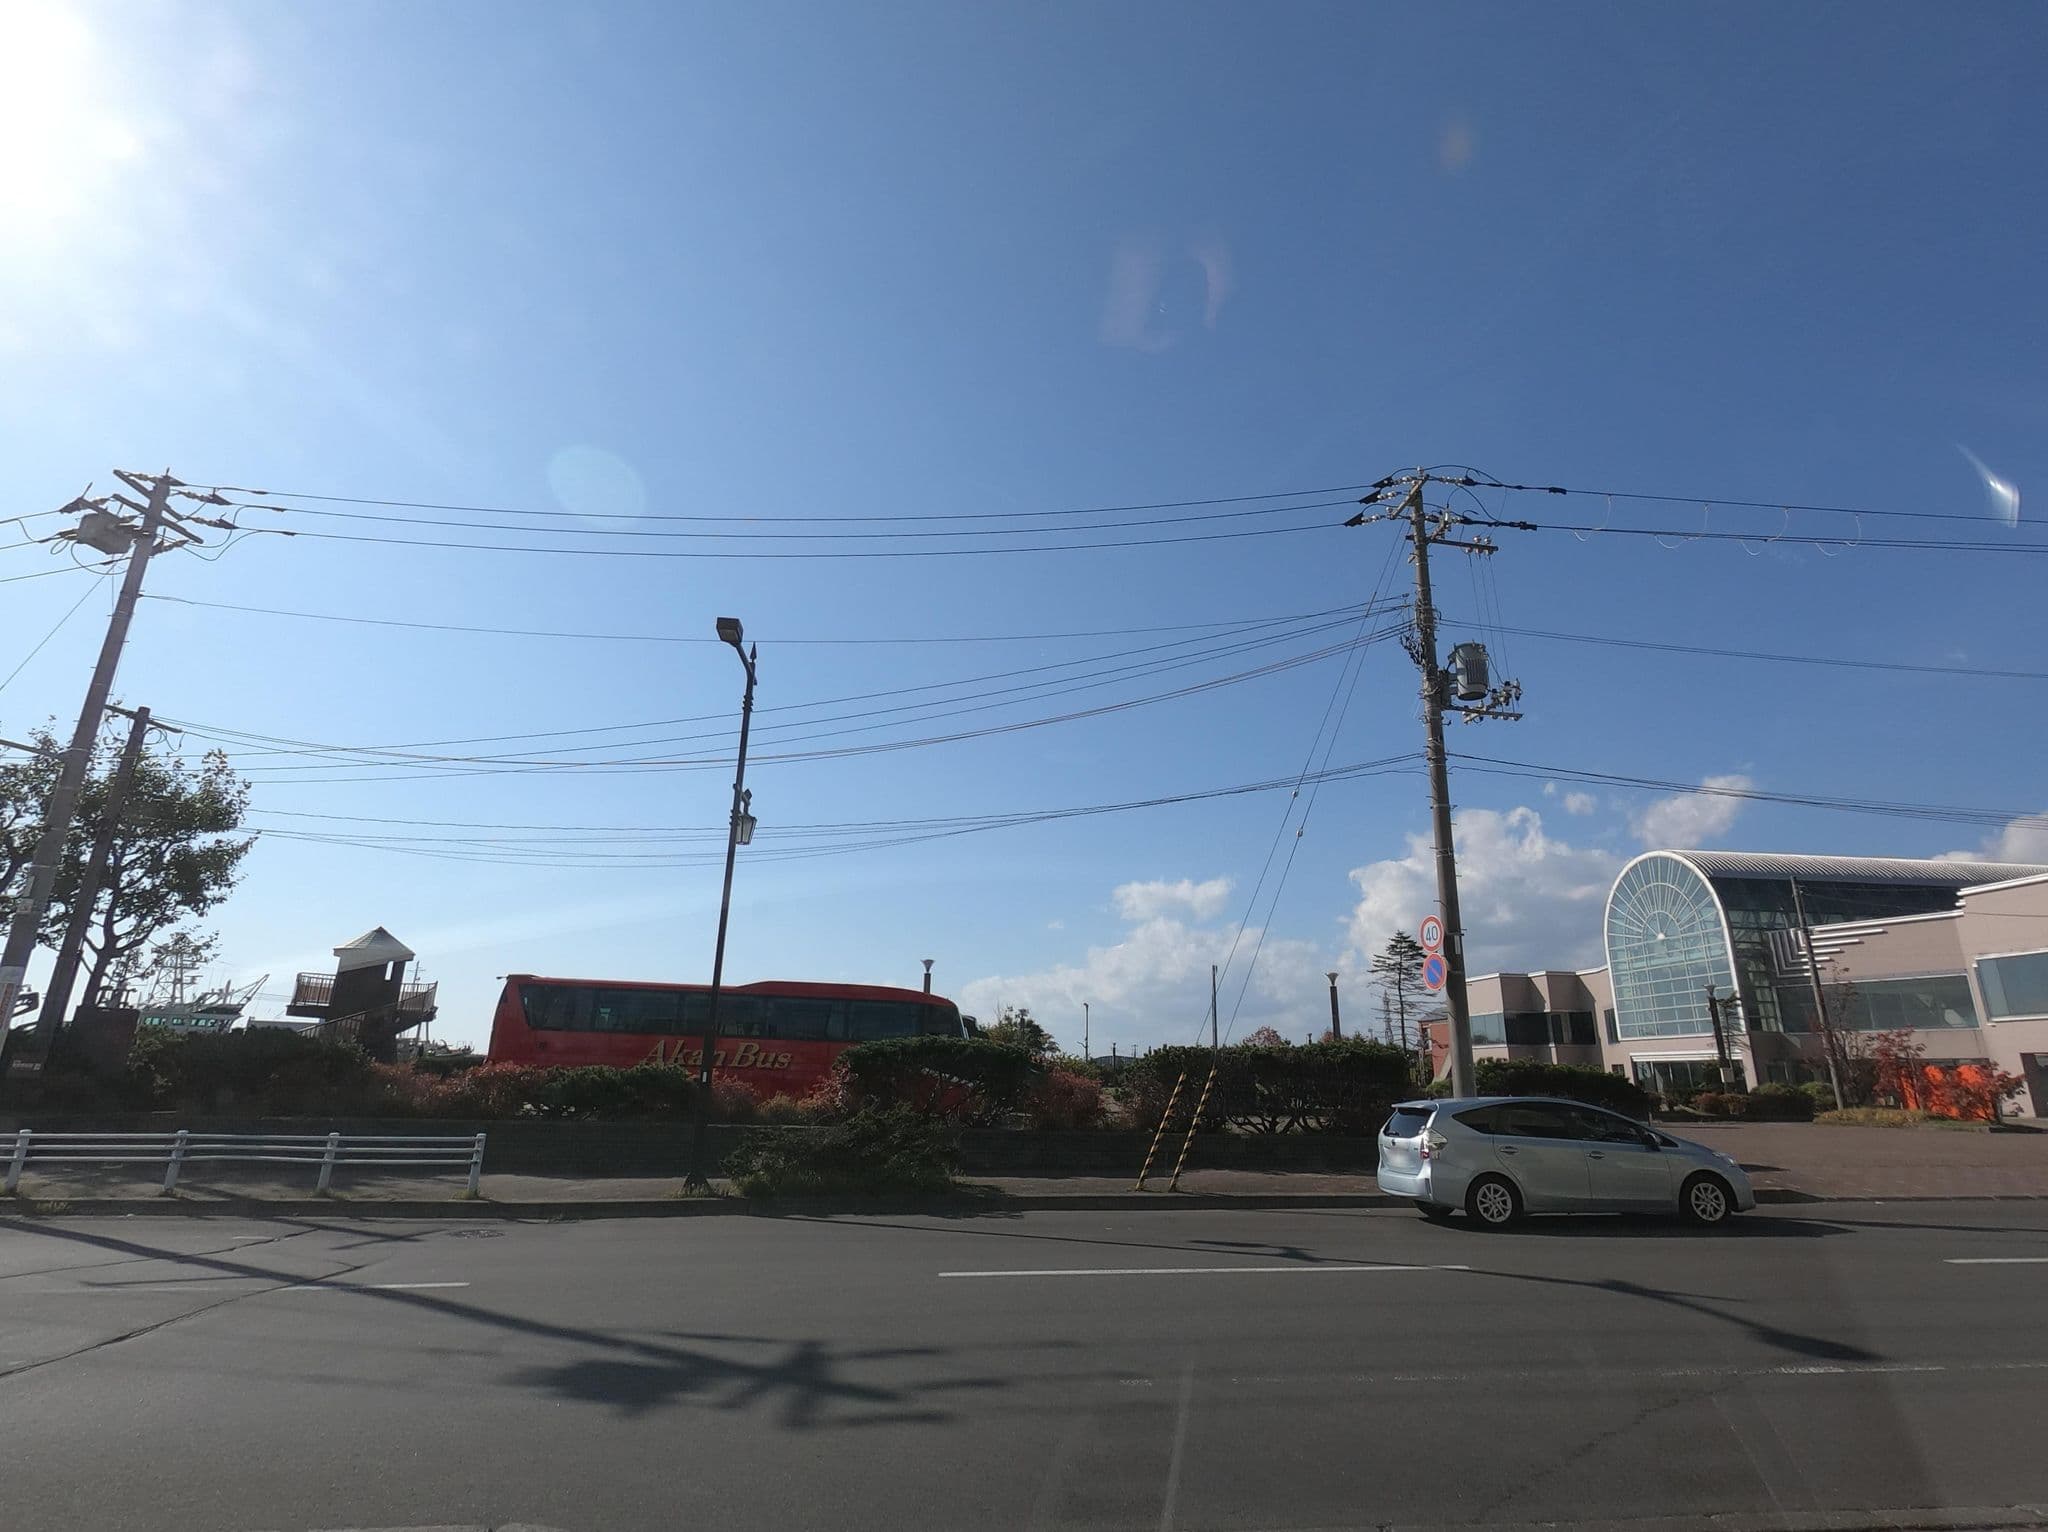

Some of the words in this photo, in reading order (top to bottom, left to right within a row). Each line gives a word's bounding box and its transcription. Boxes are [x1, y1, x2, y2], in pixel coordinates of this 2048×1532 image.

[1426, 925, 1438, 941] 40
[639, 1039, 727, 1066] Akan
[728, 1041, 793, 1069] Bus
